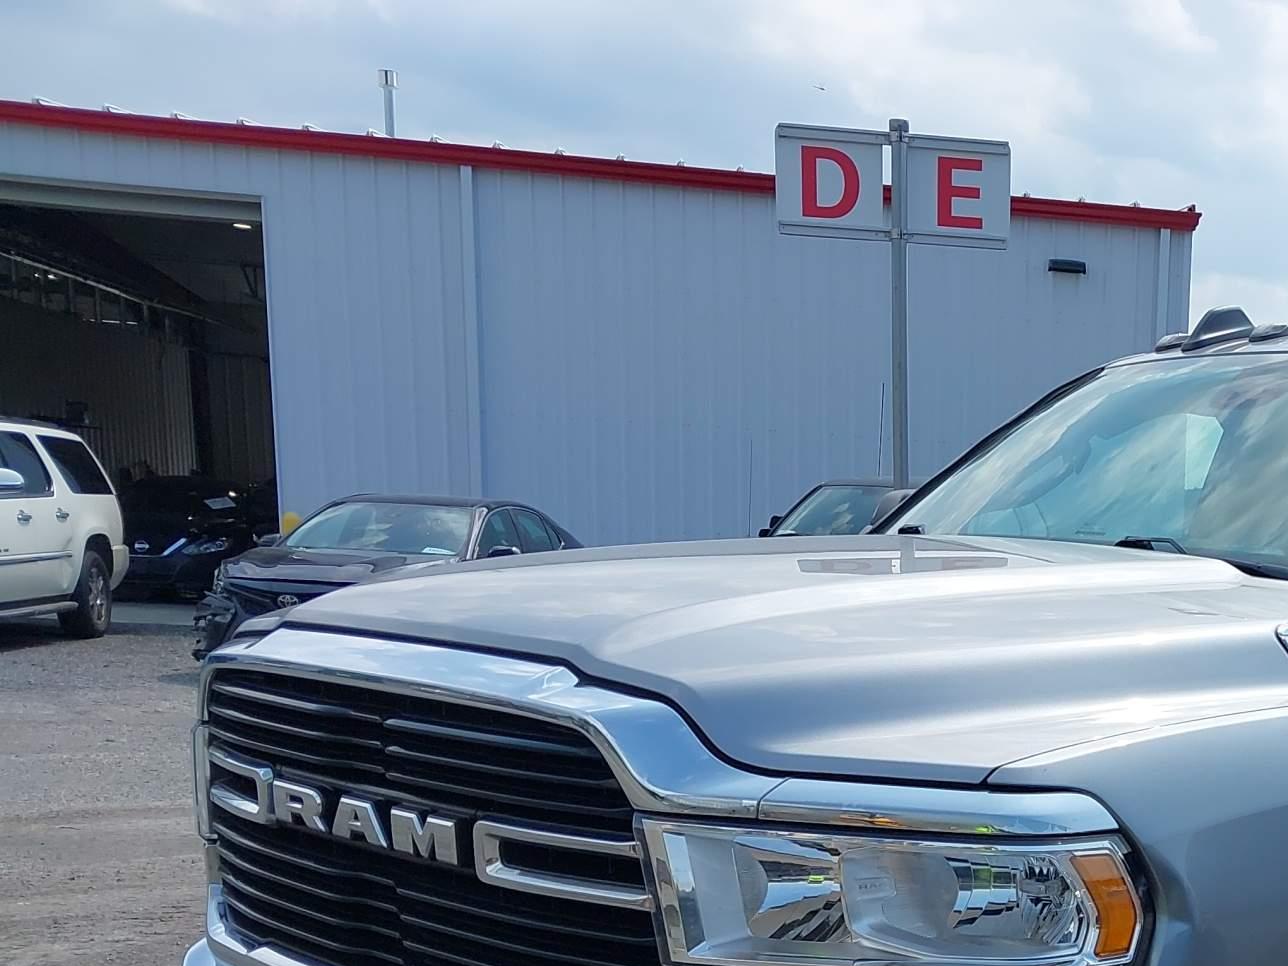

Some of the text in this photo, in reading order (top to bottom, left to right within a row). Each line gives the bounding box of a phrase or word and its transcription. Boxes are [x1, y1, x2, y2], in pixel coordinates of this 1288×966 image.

[801, 145, 860, 219] D
[936, 155, 984, 230] E
[272, 778, 459, 866] RAM
